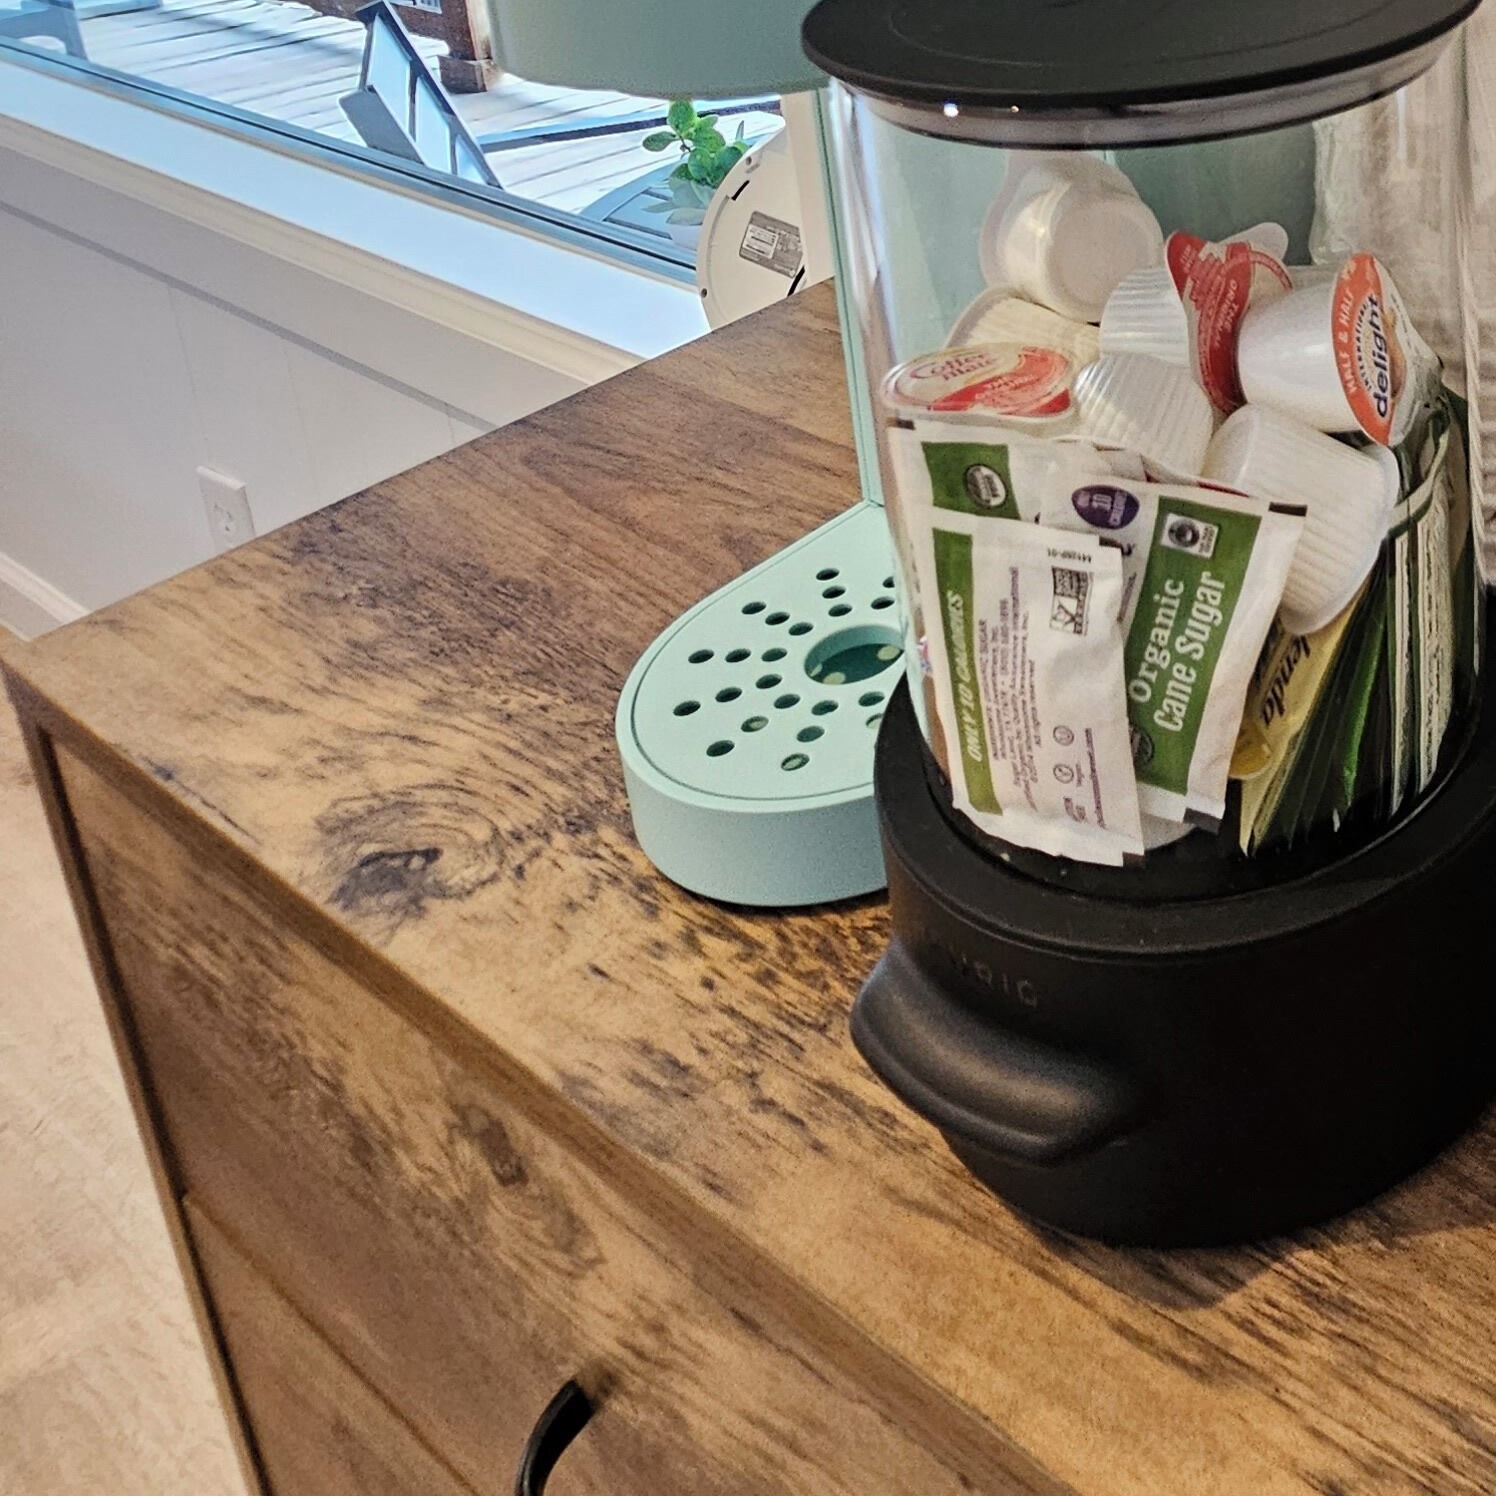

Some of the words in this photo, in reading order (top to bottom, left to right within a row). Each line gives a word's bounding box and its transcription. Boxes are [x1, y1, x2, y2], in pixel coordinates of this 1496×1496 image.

[1338, 330, 1349, 342] &
[1339, 350, 1357, 392] HALF
[1367, 294, 1387, 417] delight
[1129, 578, 1184, 703] Organic
[1153, 661, 1197, 731] Cane
[1175, 570, 1224, 660] Sugar
[961, 708, 981, 761] ONLY
